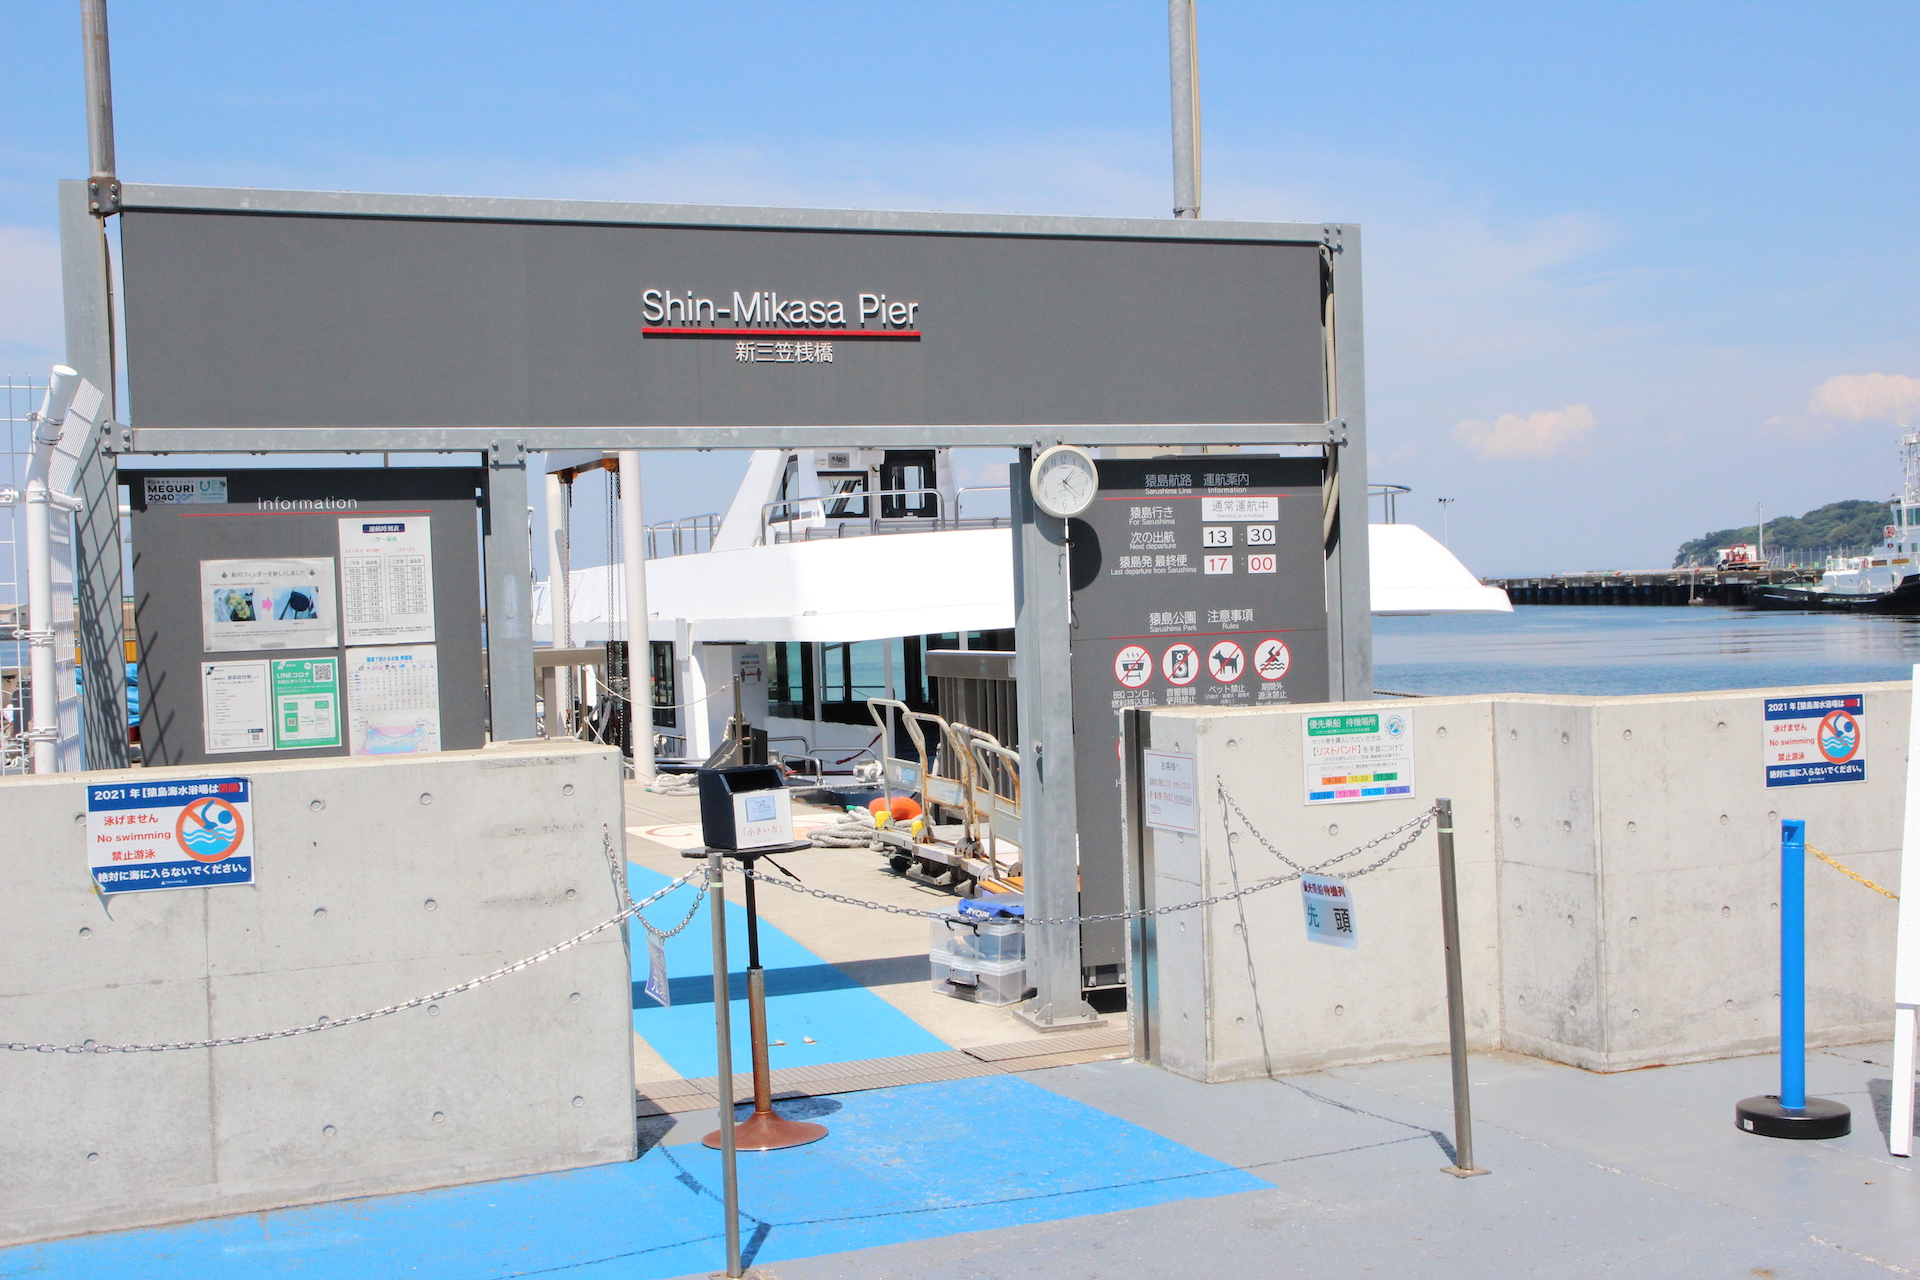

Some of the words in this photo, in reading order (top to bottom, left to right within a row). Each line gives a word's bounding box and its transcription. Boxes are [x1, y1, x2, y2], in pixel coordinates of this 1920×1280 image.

[642, 289, 846, 325] Shin-Mikasa
[859, 293, 919, 326] Pier
[735, 341, 833, 363] 新三笠桟橋
[1145, 474, 1192, 487] 猿島航路
[1203, 473, 1249, 486] 運航案内
[147, 485, 194, 493] MEGURI
[257, 496, 358, 511] Information
[1130, 506, 1174, 519] 猿島行き
[1212, 500, 1268, 512] 通常運航中
[1131, 531, 1175, 543] 次の出航
[1208, 530, 1227, 544] 13
[1251, 528, 1272, 542] 30
[1119, 555, 1152, 568] 猿島発
[1155, 554, 1187, 567] 最終便
[1209, 558, 1227, 571] 17
[1251, 557, 1273, 571] 00
[1168, 566, 1196, 574] Sarushima
[1149, 611, 1196, 626] 猿島公園
[1207, 609, 1253, 623] 注意事項
[1208, 684, 1245, 693] ペット禁止
[1261, 682, 1283, 691] 期間外
[1258, 691, 1287, 700] 遊泳禁止
[1768, 703, 1788, 711] 2021
[1773, 723, 1807, 733] 泳げません
[1781, 738, 1815, 746] swimming
[1778, 752, 1805, 761] 禁止游泳
[1769, 765, 1862, 779] 絶対に海に入らないでください。
[94, 789, 126, 801] 2021
[104, 813, 159, 826] 泳げません
[97, 834, 112, 843] No
[116, 830, 171, 843] swimming
[743, 825, 783, 837] 「小さい方」
[112, 849, 155, 861] 禁止游泳
[98, 863, 247, 883] 絶対に海に入らないでください。
